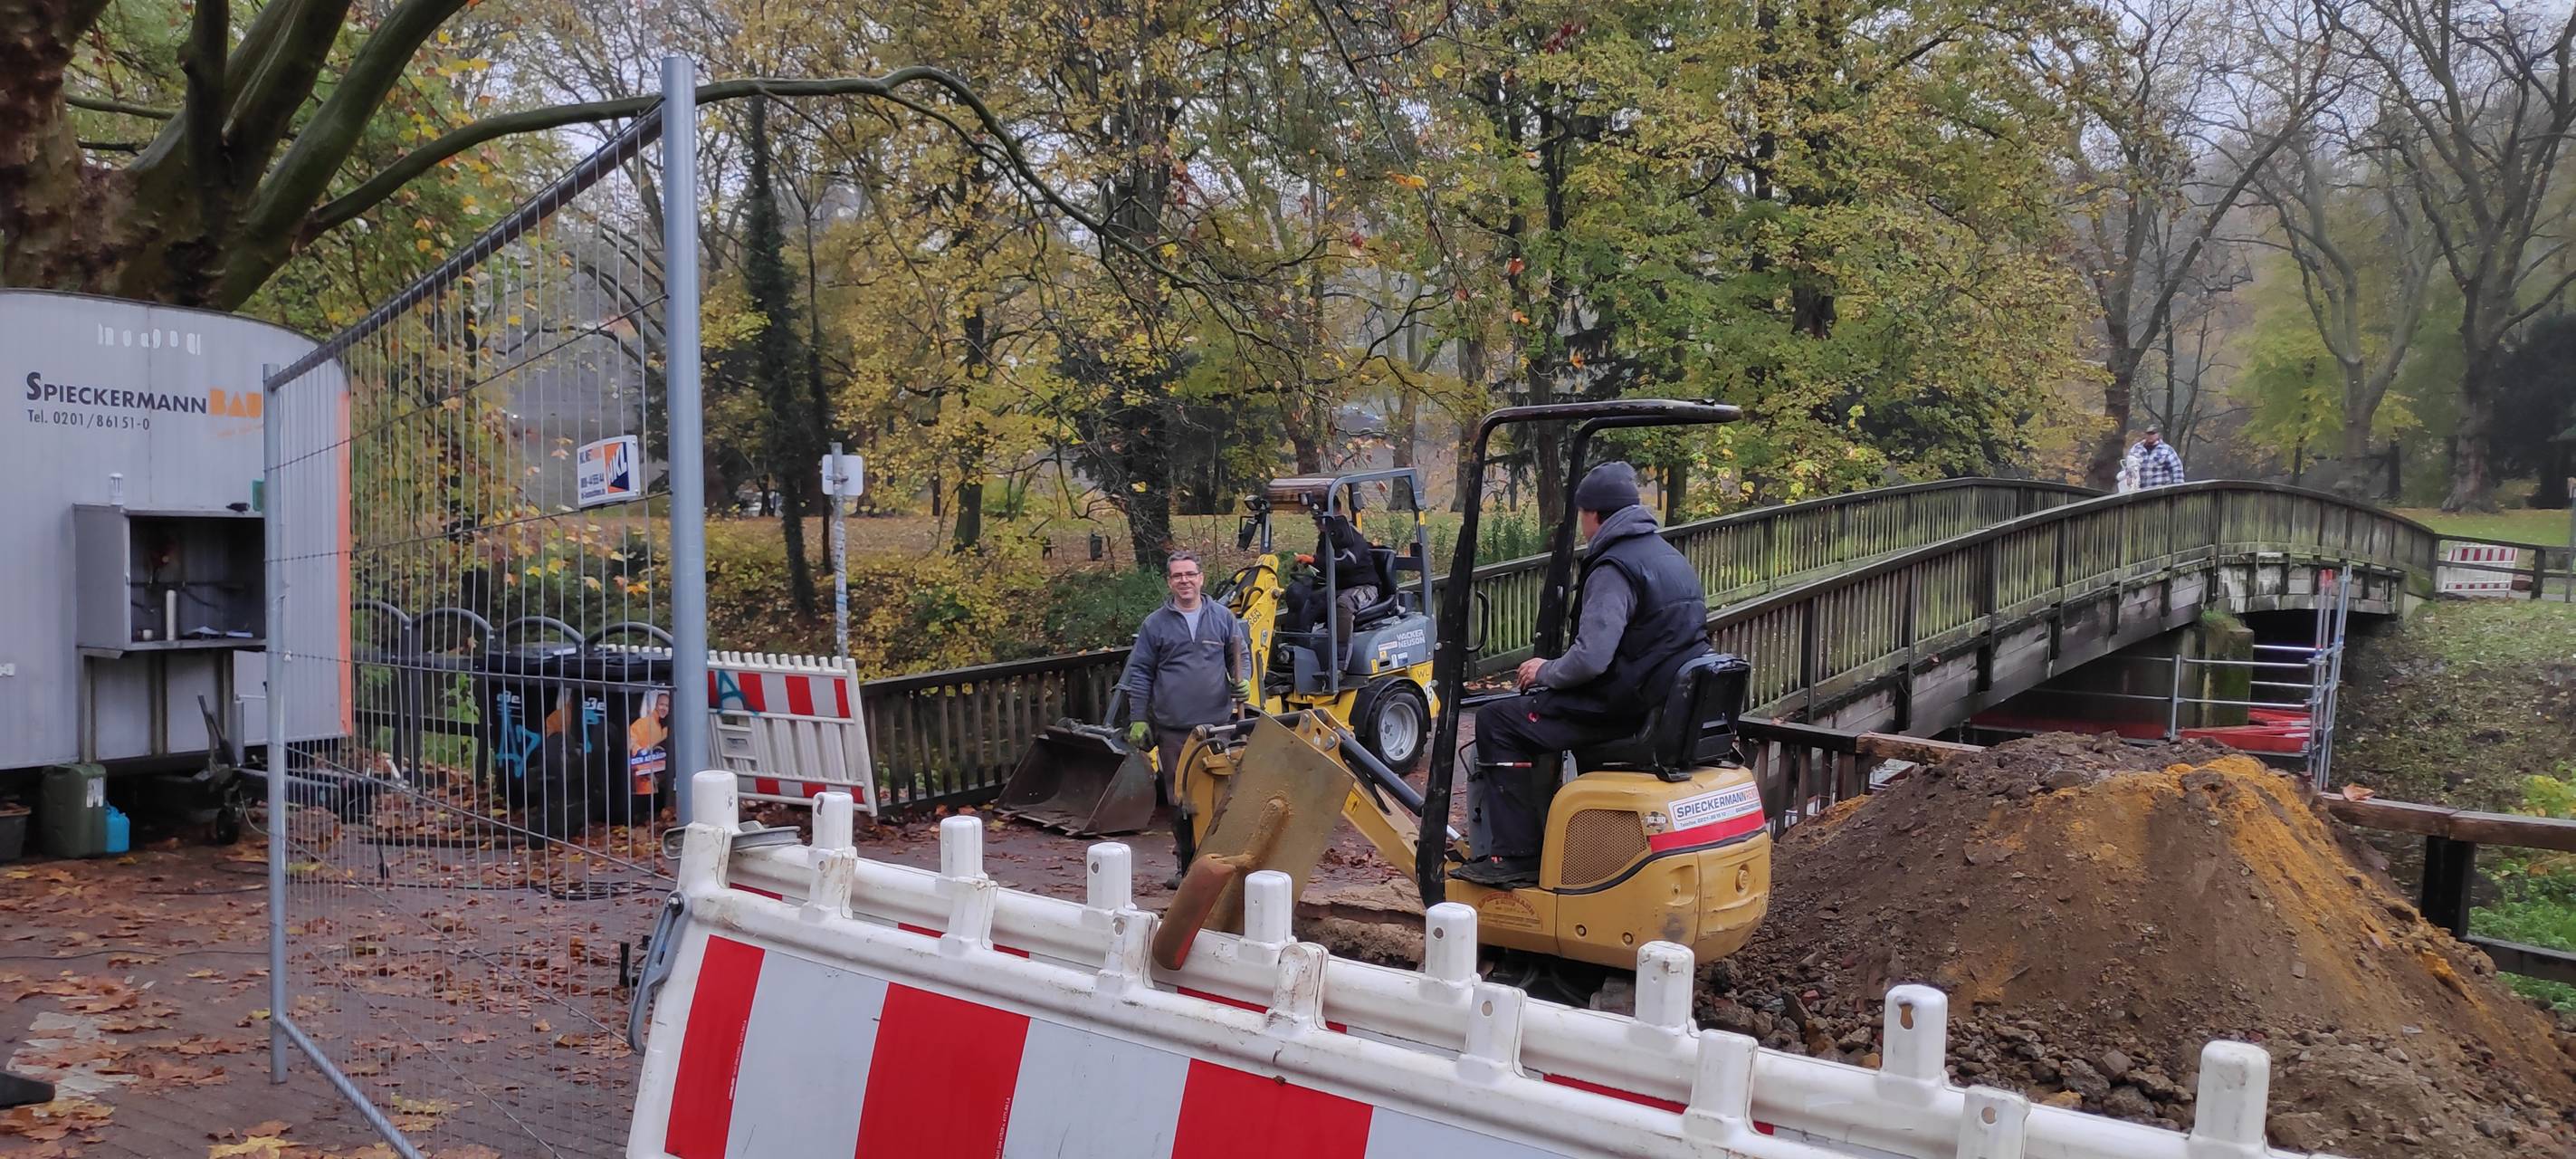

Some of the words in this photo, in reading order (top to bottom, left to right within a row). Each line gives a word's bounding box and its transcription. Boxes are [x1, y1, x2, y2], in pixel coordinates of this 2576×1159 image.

[27, 408, 48, 424] Tel.
[53, 410, 150, 431] 0201/86151-0
[1397, 629, 1424, 640] WACKER
[1398, 637, 1426, 648] NEUSON
[1676, 790, 1746, 818] SPIECKERMANN
